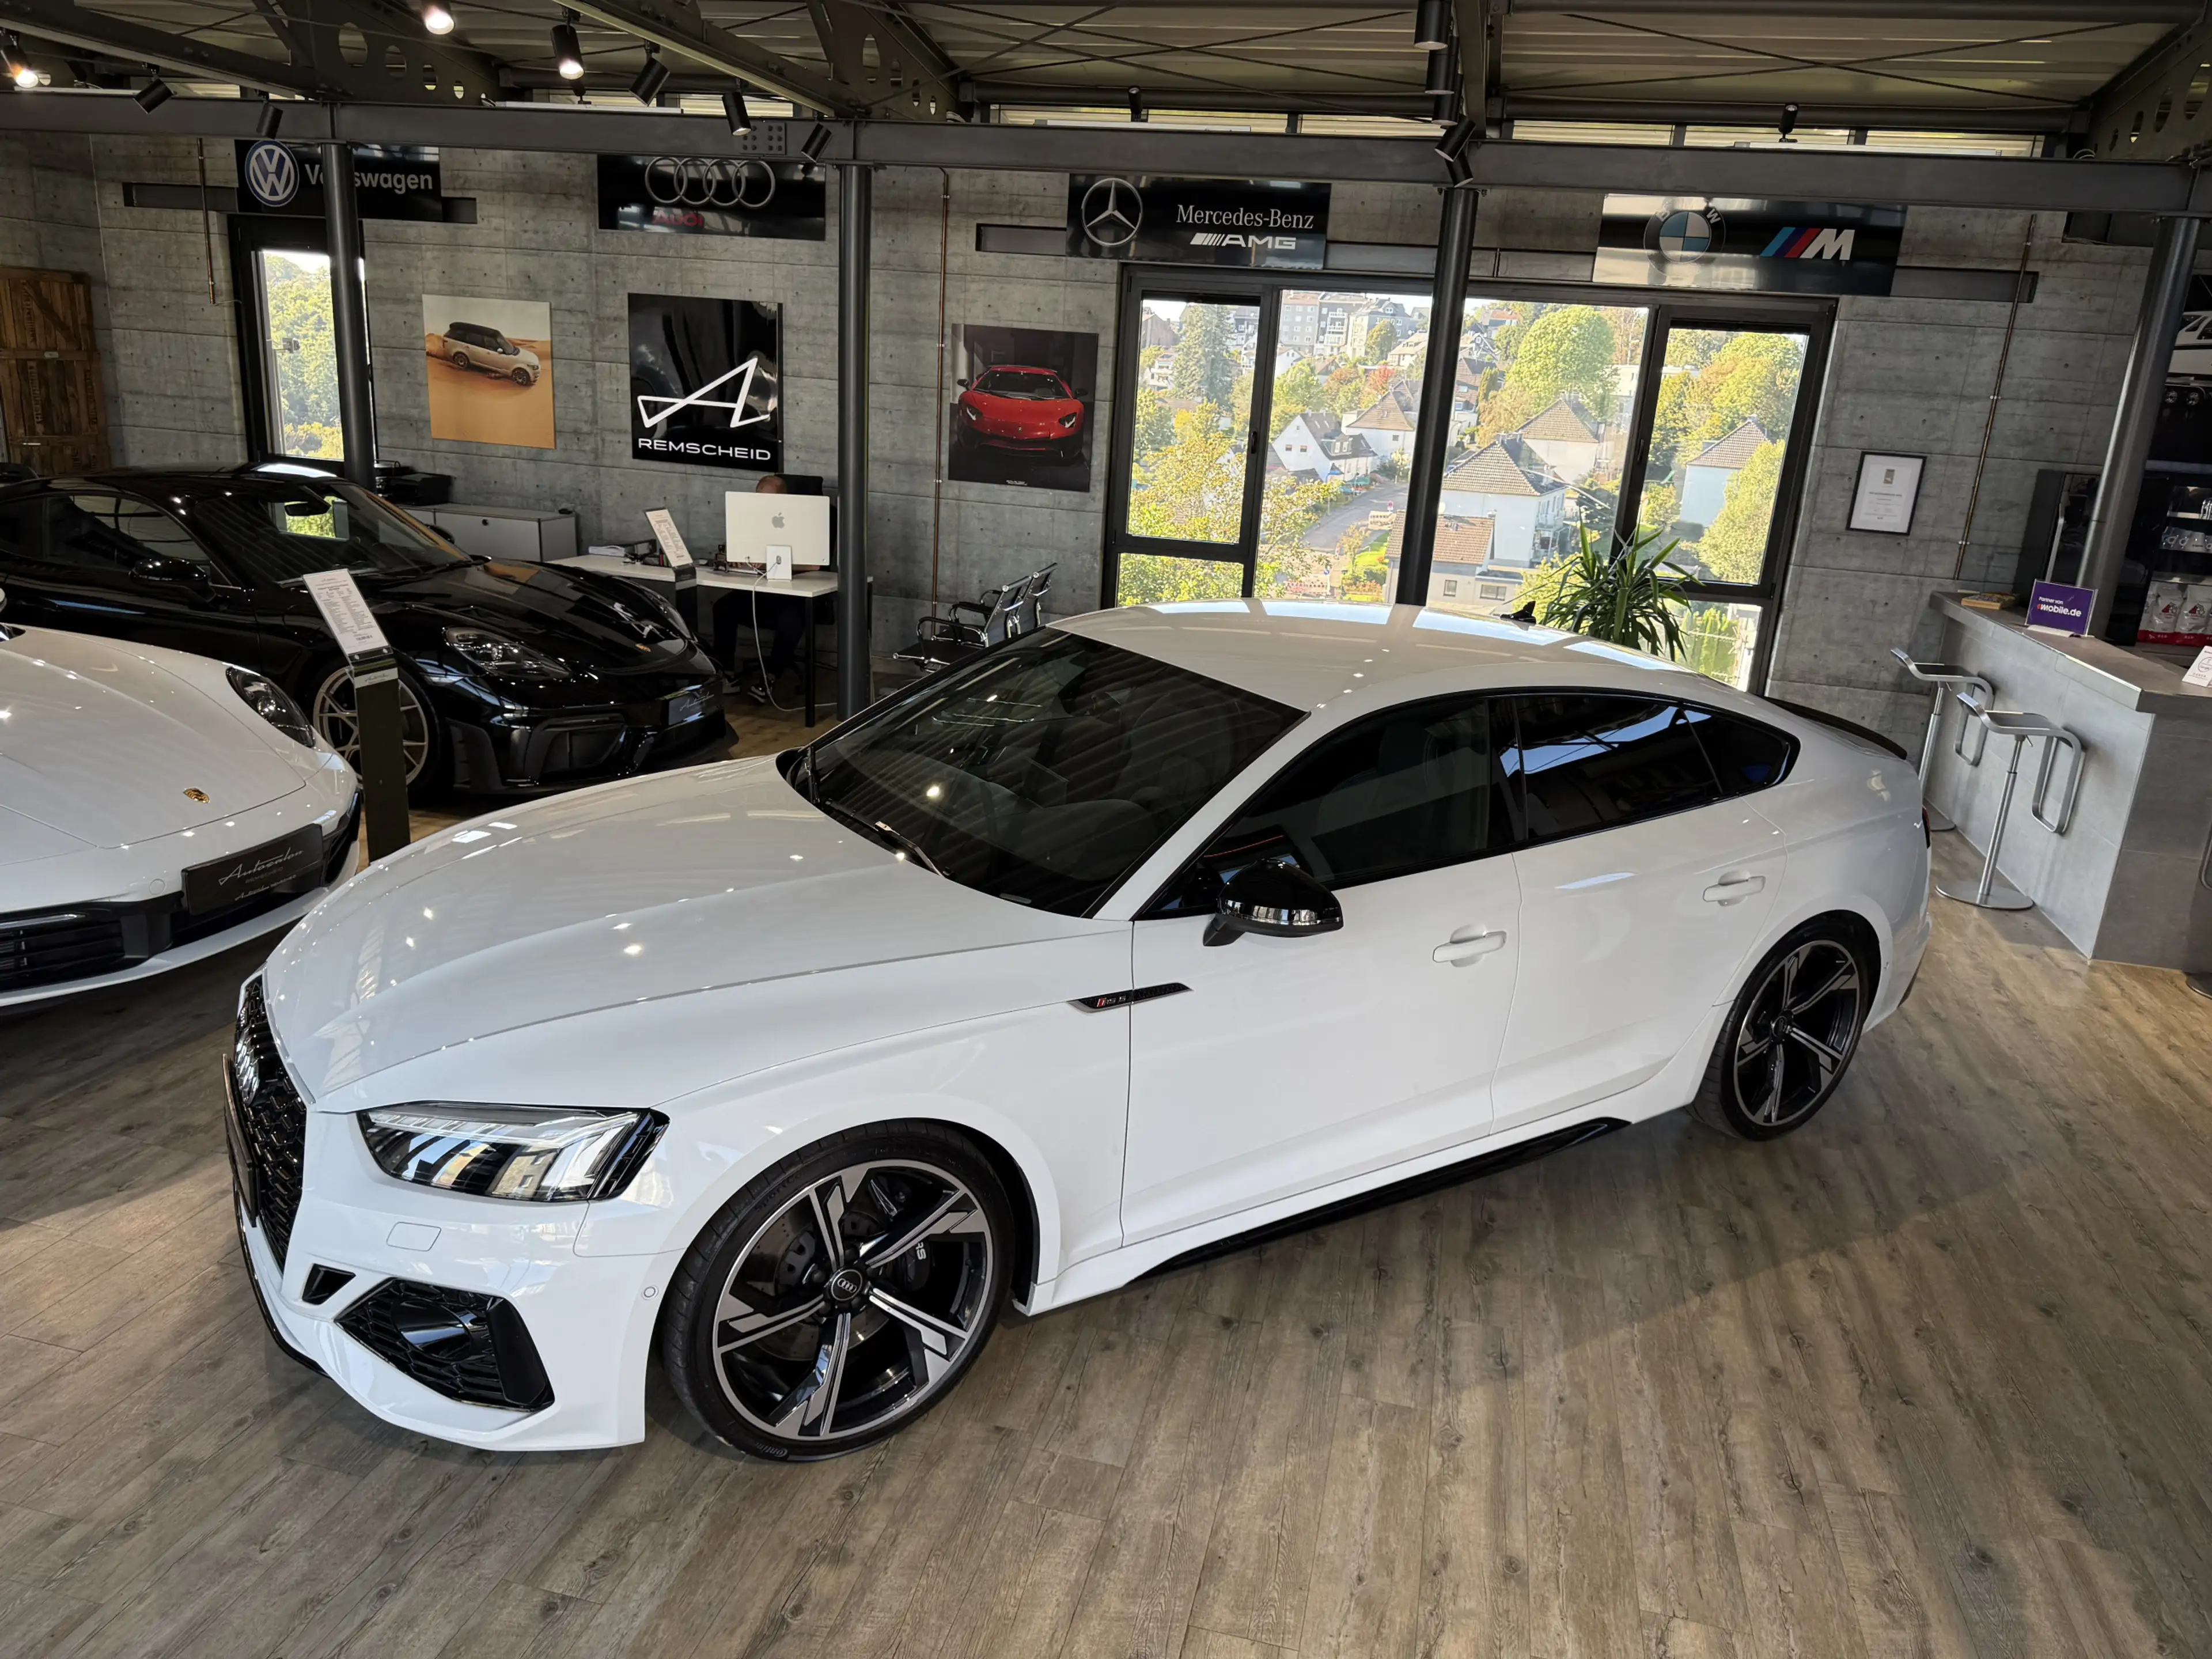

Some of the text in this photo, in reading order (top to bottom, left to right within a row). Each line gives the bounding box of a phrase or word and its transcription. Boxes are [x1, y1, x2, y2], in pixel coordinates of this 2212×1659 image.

[305, 164, 433, 195] Vswagen
[652, 209, 704, 226] Audi
[1176, 204, 1315, 229] Mercedes-Benz
[1222, 234, 1297, 250] AMG
[1799, 228, 1855, 260] M
[638, 438, 771, 460] REMSCHEID
[2040, 604, 2082, 617] mobile.de
[915, 1241, 927, 1260] RS
